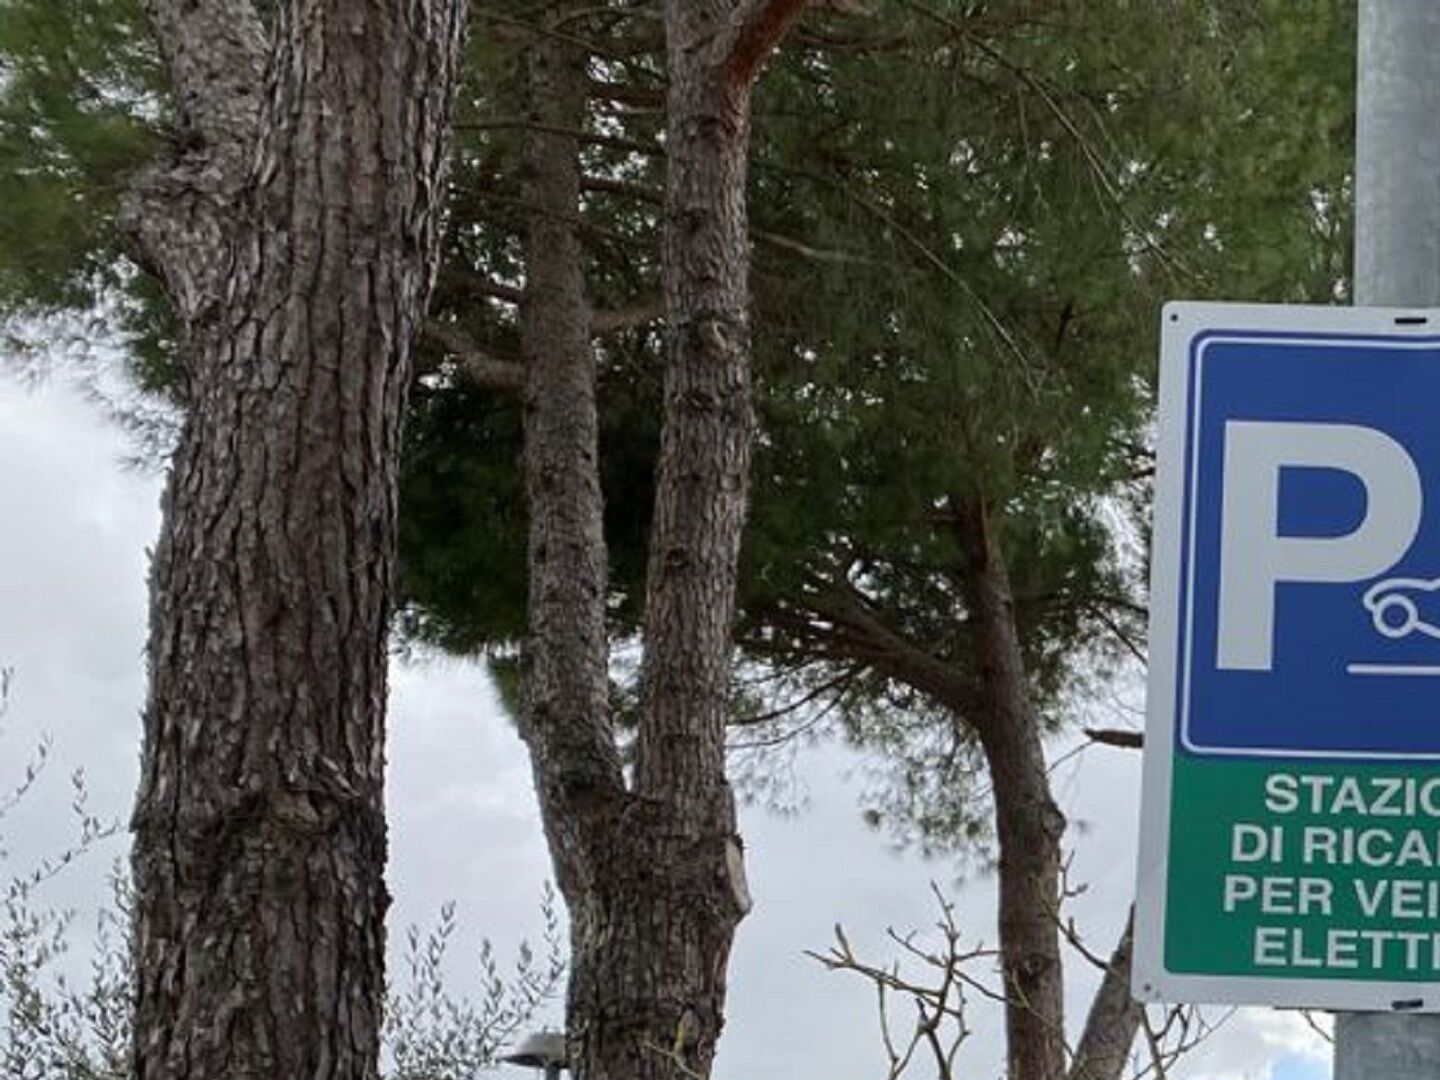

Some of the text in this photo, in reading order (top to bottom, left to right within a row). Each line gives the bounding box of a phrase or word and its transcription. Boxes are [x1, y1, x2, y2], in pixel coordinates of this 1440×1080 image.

[1216, 419, 1424, 672] P
[1232, 824, 1283, 863] DI
[1224, 875, 1334, 914] PER
